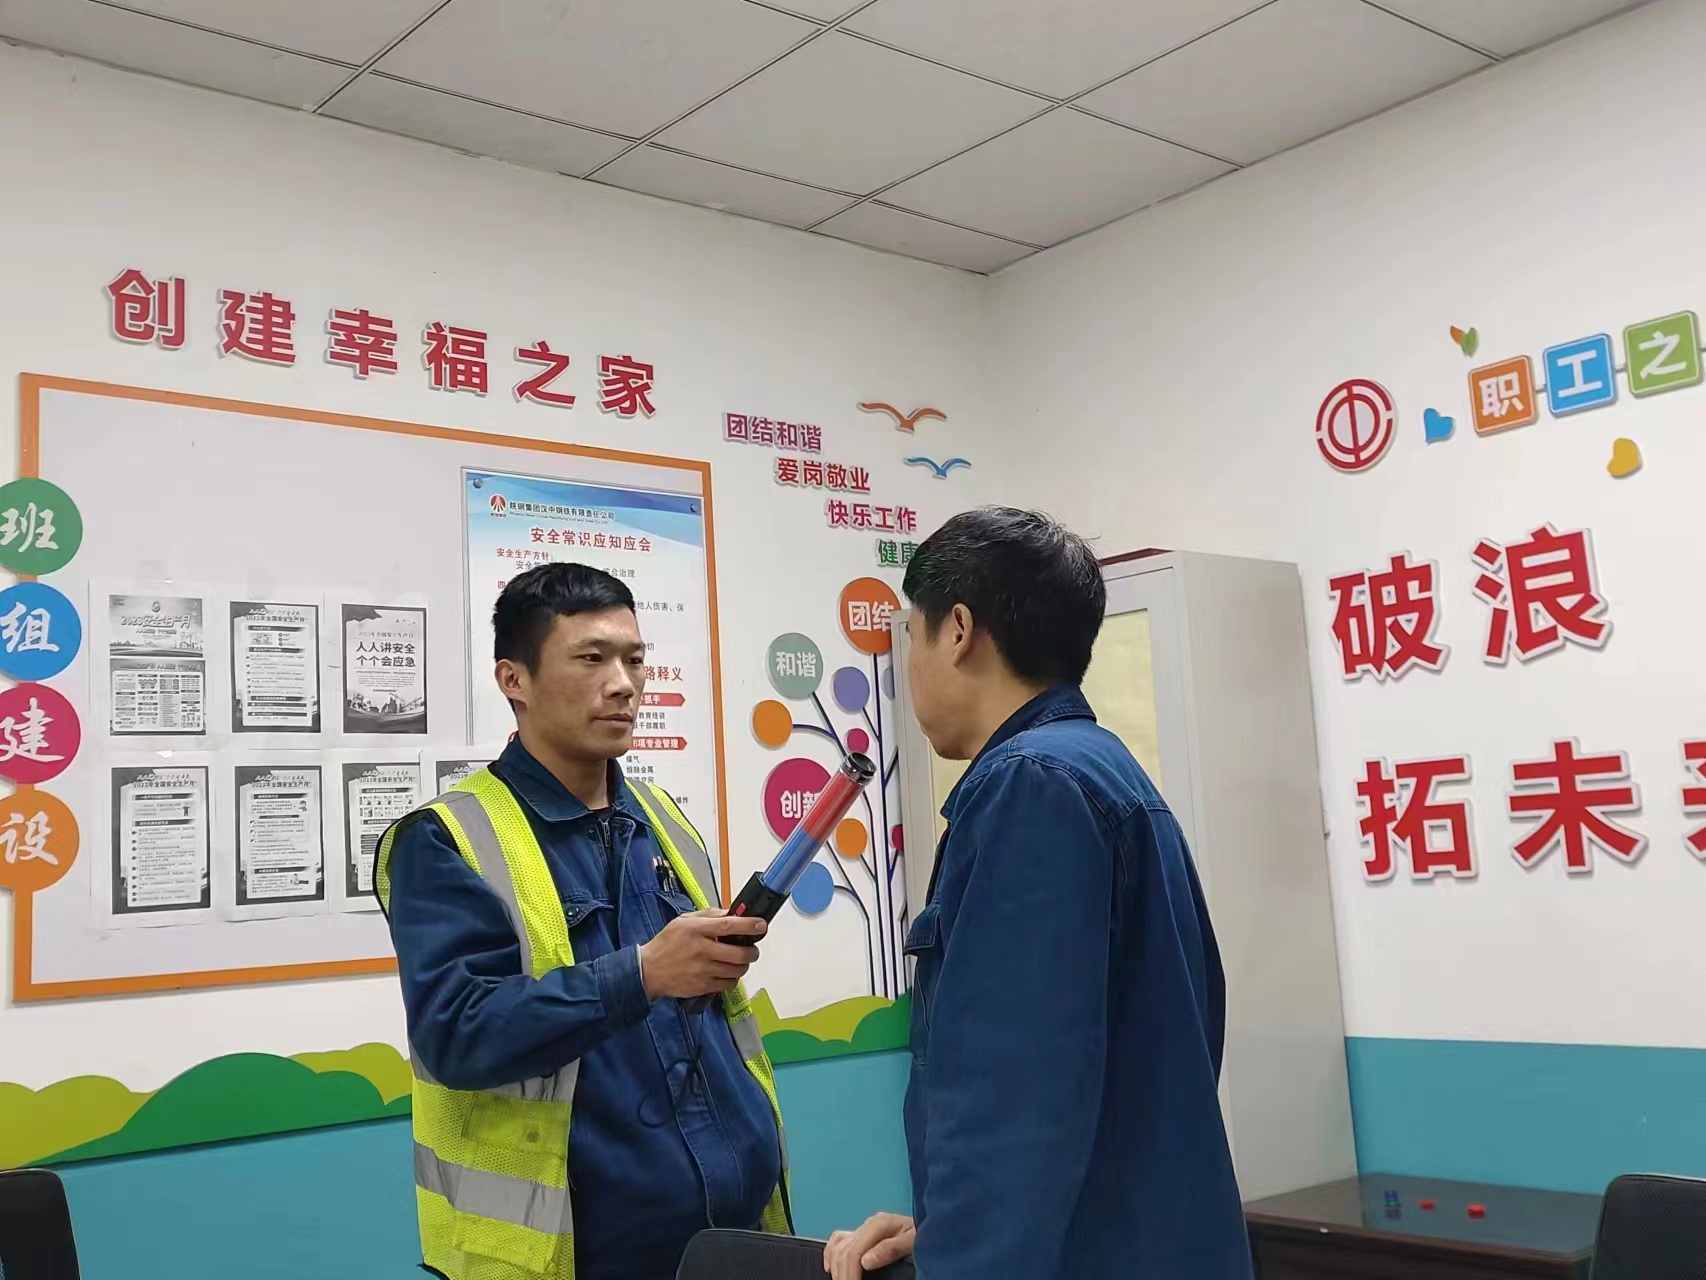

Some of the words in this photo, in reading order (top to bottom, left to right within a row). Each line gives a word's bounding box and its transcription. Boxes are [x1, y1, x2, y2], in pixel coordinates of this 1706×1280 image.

[106, 267, 657, 417] 创建幸福之家
[1477, 330, 1688, 418] 职工之
[725, 412, 822, 451] 团结和谐
[777, 457, 871, 492] 爱岗敬业
[508, 501, 615, 521] 陕钢集团汉中钢铁有限责任公司
[827, 499, 917, 532] 快乐工作
[530, 527, 652, 552] 安全常识应知应会
[847, 600, 895, 632] 团结
[1328, 525, 1608, 676] 破浪
[355, 640, 416, 654] 人人讲安全
[355, 655, 416, 668] 个个会应急
[775, 651, 817, 679] 和谐
[1356, 740, 1706, 877] 拓未
